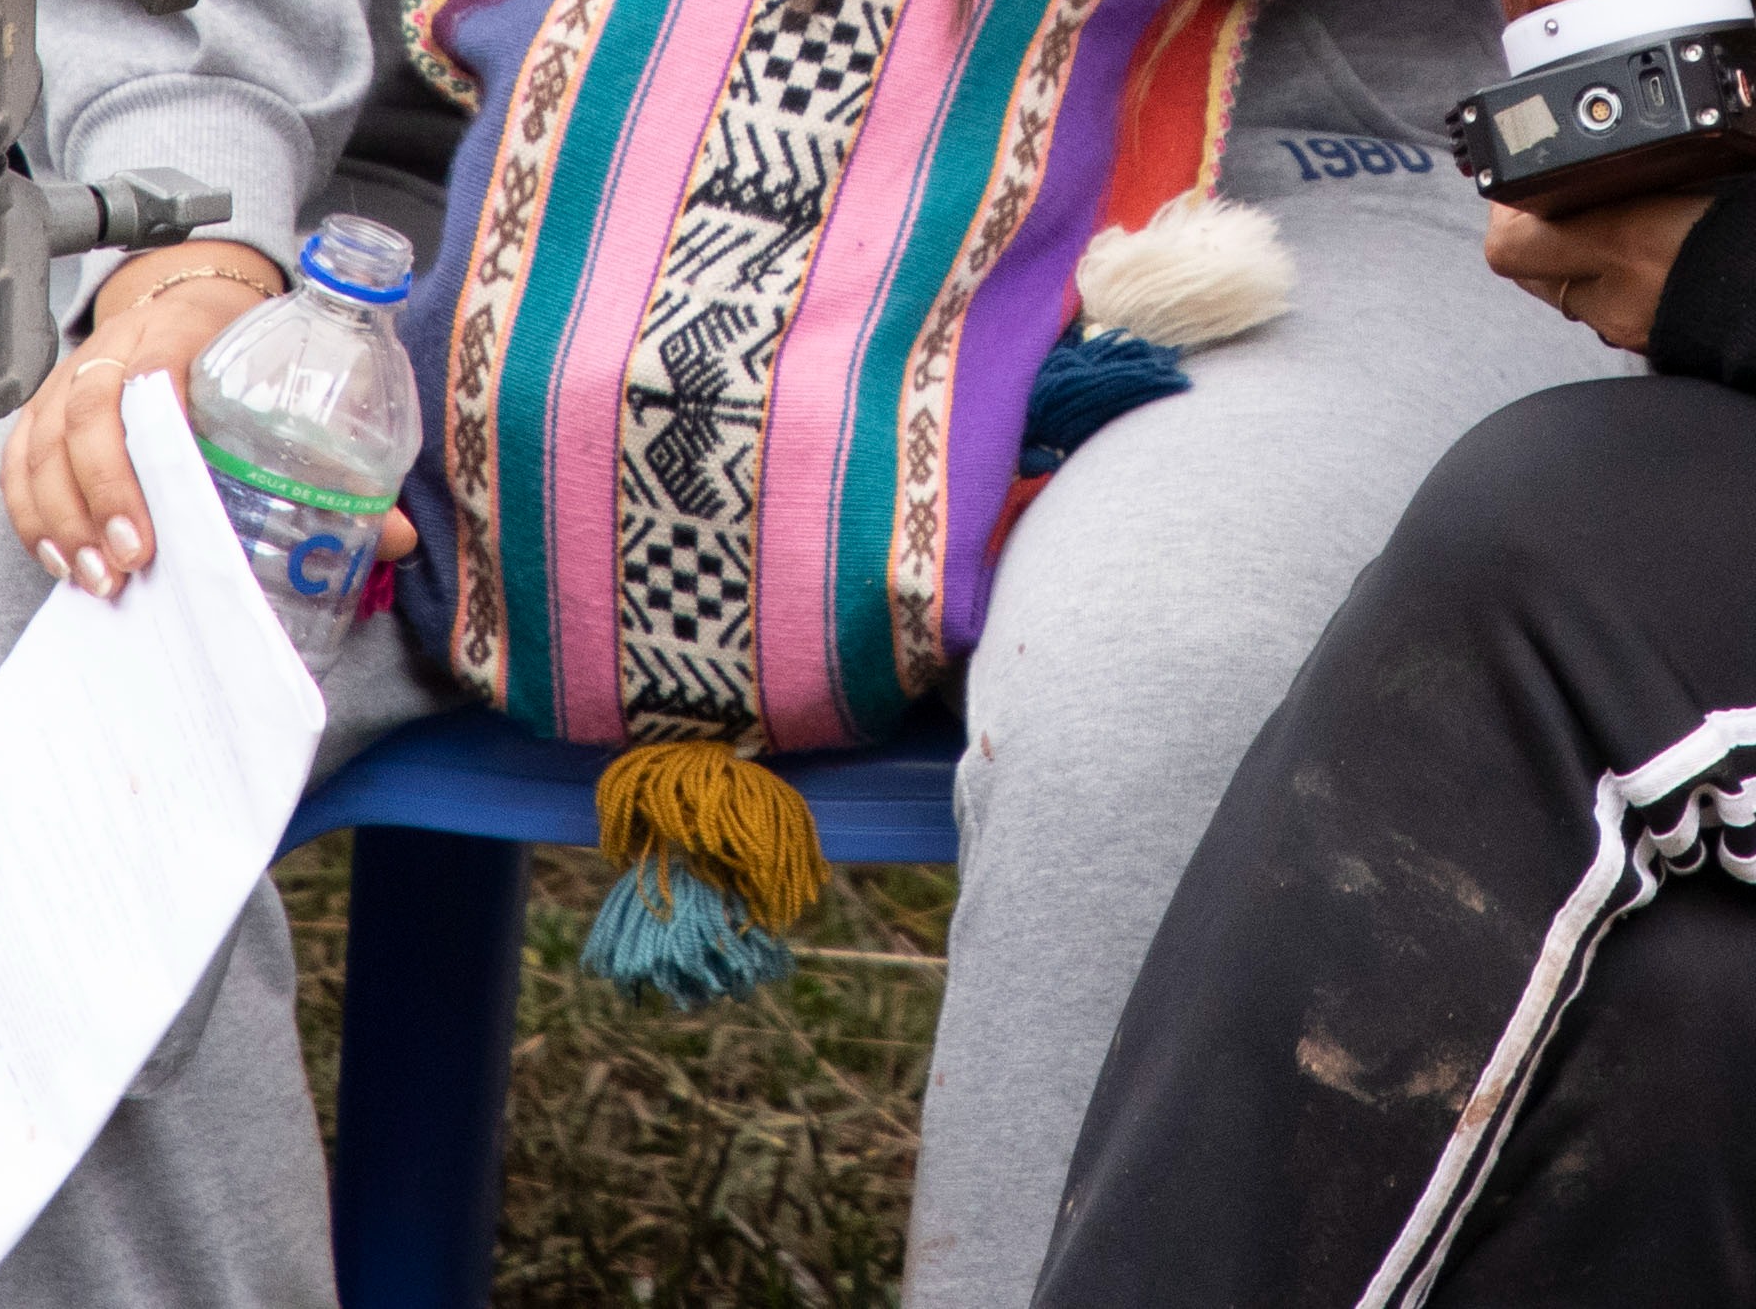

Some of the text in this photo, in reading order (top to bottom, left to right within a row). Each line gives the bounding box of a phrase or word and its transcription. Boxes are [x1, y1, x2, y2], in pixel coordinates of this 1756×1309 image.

[1278, 138, 1434, 181] 1980
[246, 471, 288, 492] AGUA
[291, 486, 313, 500] DE
